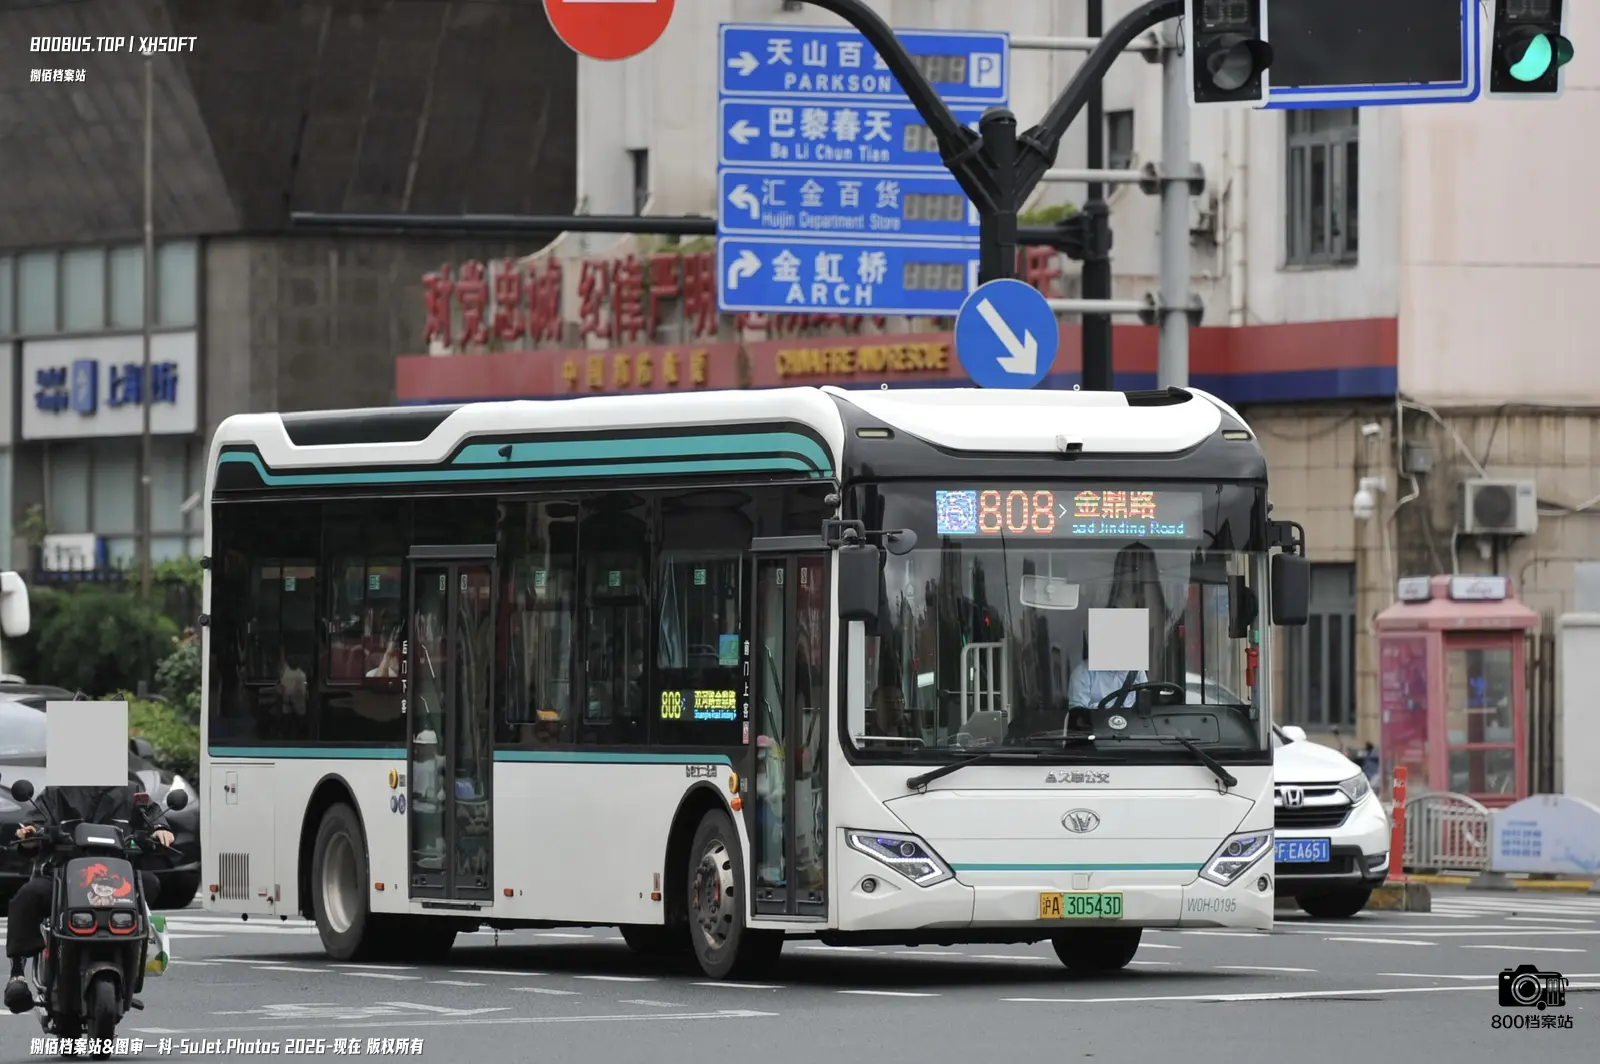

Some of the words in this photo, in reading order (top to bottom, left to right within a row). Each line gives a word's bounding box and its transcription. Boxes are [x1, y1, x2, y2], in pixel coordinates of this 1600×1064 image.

[784, 72, 891, 92] PARKSON
[768, 107, 893, 142] 巴黎春天
[770, 142, 788, 159] Ba
[795, 143, 809, 160] Li
[815, 143, 853, 161] Chun
[858, 144, 890, 162] Tian
[761, 178, 901, 209] 汇金百货
[761, 210, 795, 231] Huijin
[799, 210, 865, 231] Department
[869, 212, 902, 231] Store
[771, 248, 888, 285] 金虹桥
[785, 281, 873, 306] ARCH
[978, 490, 1055, 534] 808
[1073, 490, 1156, 519] 金鼎路
[1098, 521, 1146, 537] Jinding
[1150, 521, 1184, 535] Road
[1290, 843, 1326, 859] EA651
[1067, 895, 1122, 915] 30543D
